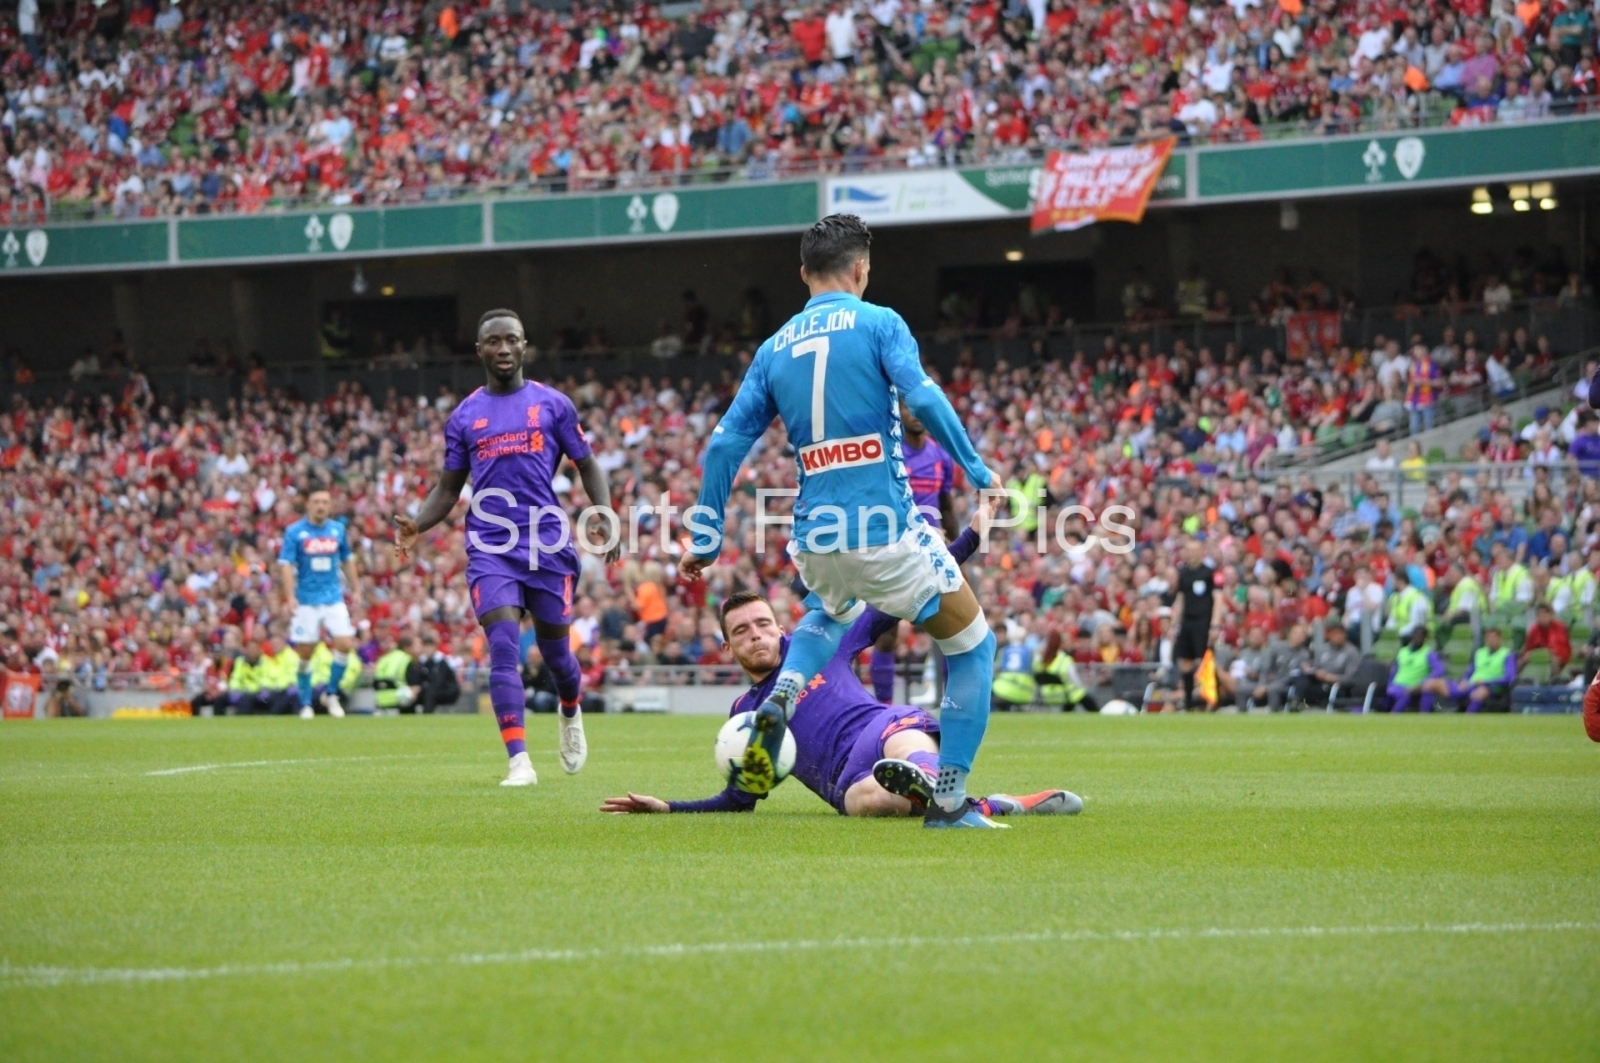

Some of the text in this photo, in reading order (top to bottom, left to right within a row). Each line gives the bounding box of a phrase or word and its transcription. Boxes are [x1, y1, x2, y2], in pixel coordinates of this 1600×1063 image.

[774, 308, 857, 352] CALLEJÓN
[792, 336, 830, 442] 7
[477, 430, 528, 448] Standard
[477, 442, 529, 460] Chartered
[801, 439, 882, 470] KIMBO
